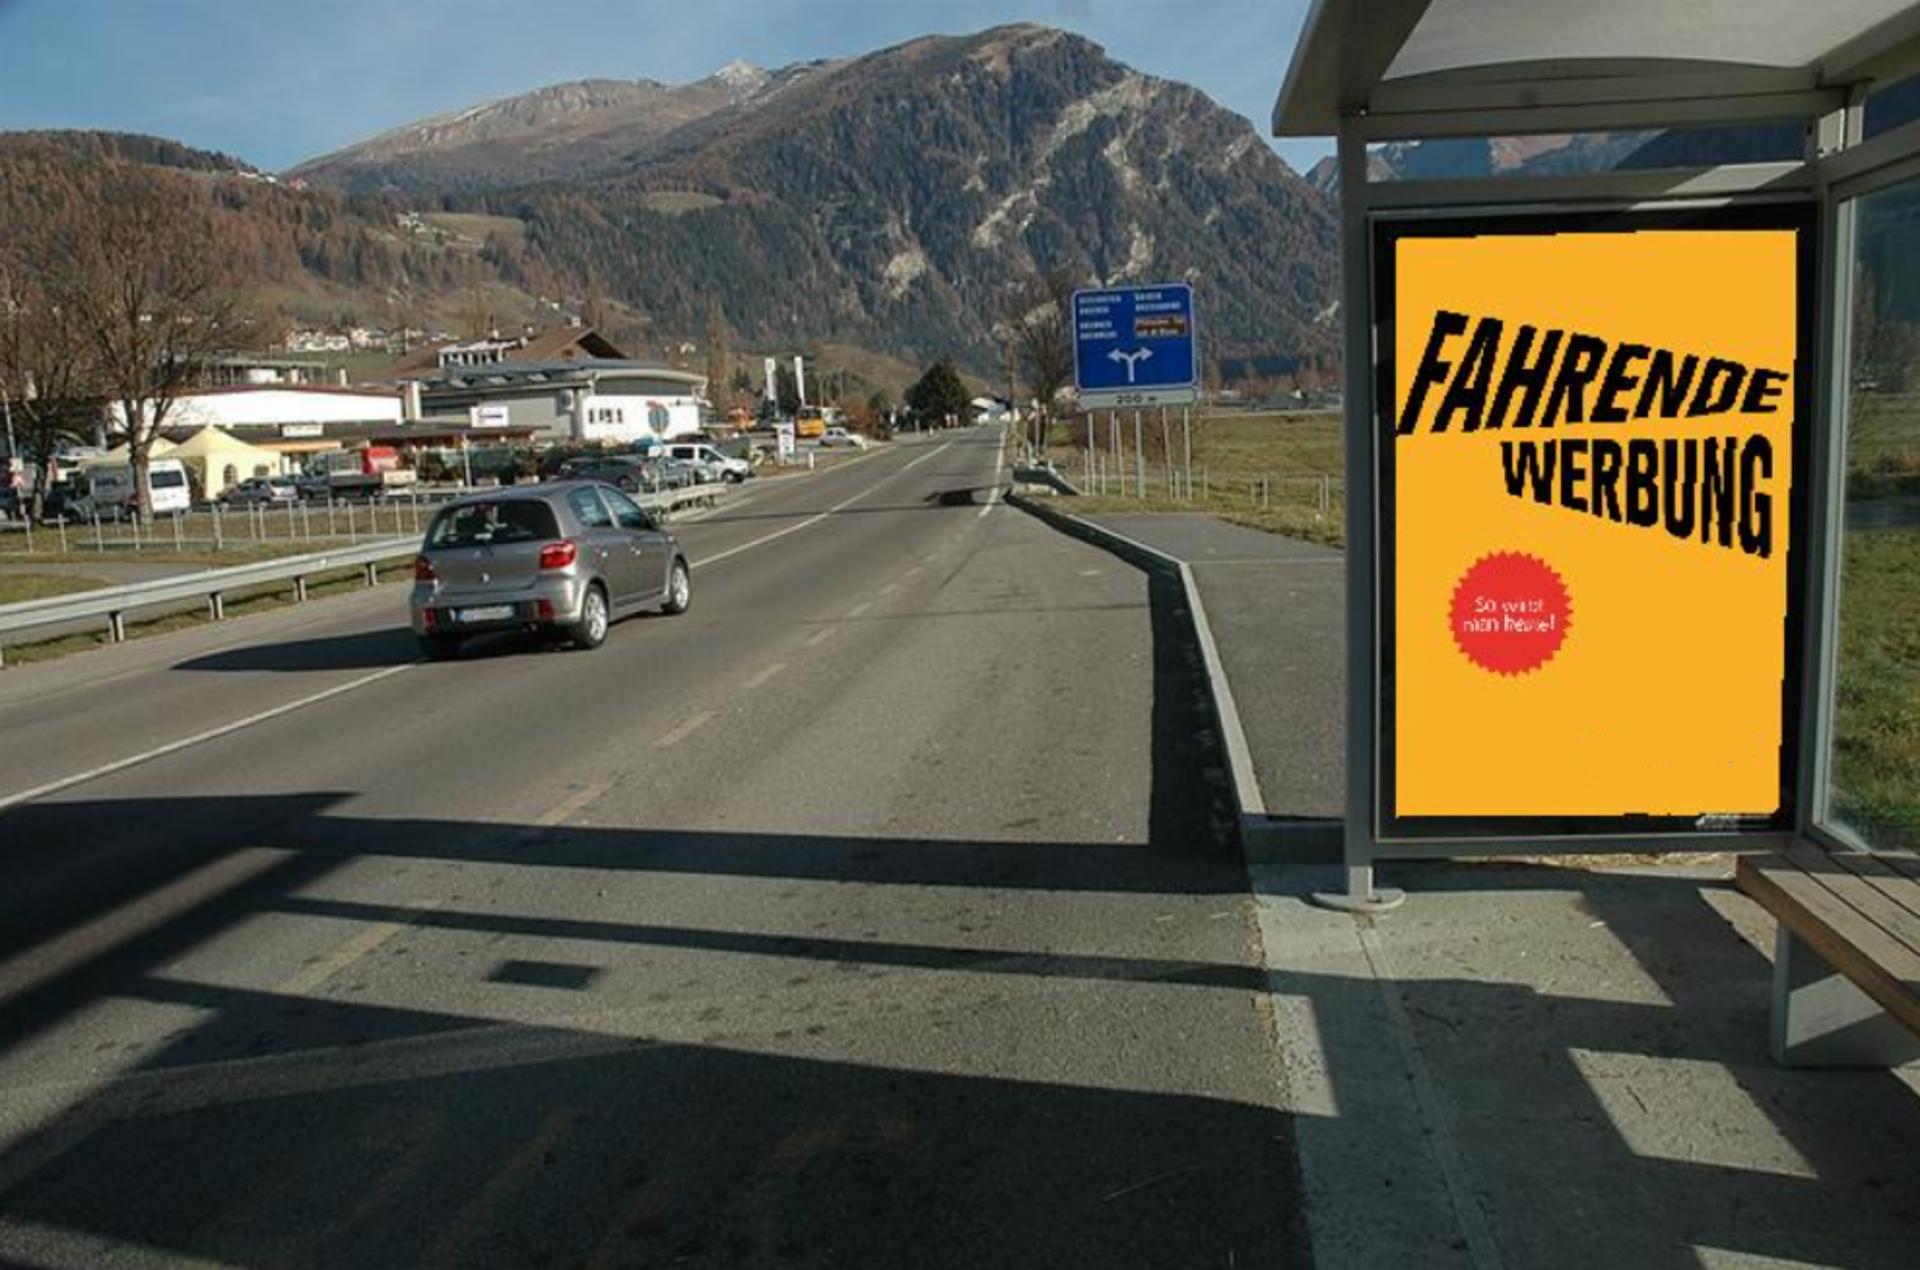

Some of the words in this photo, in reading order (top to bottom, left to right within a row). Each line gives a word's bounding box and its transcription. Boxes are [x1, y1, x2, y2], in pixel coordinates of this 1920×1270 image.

[1396, 309, 1789, 437] FAHRENDE
[1500, 433, 1774, 559] WERBUNG
[1474, 595, 1497, 613] So
